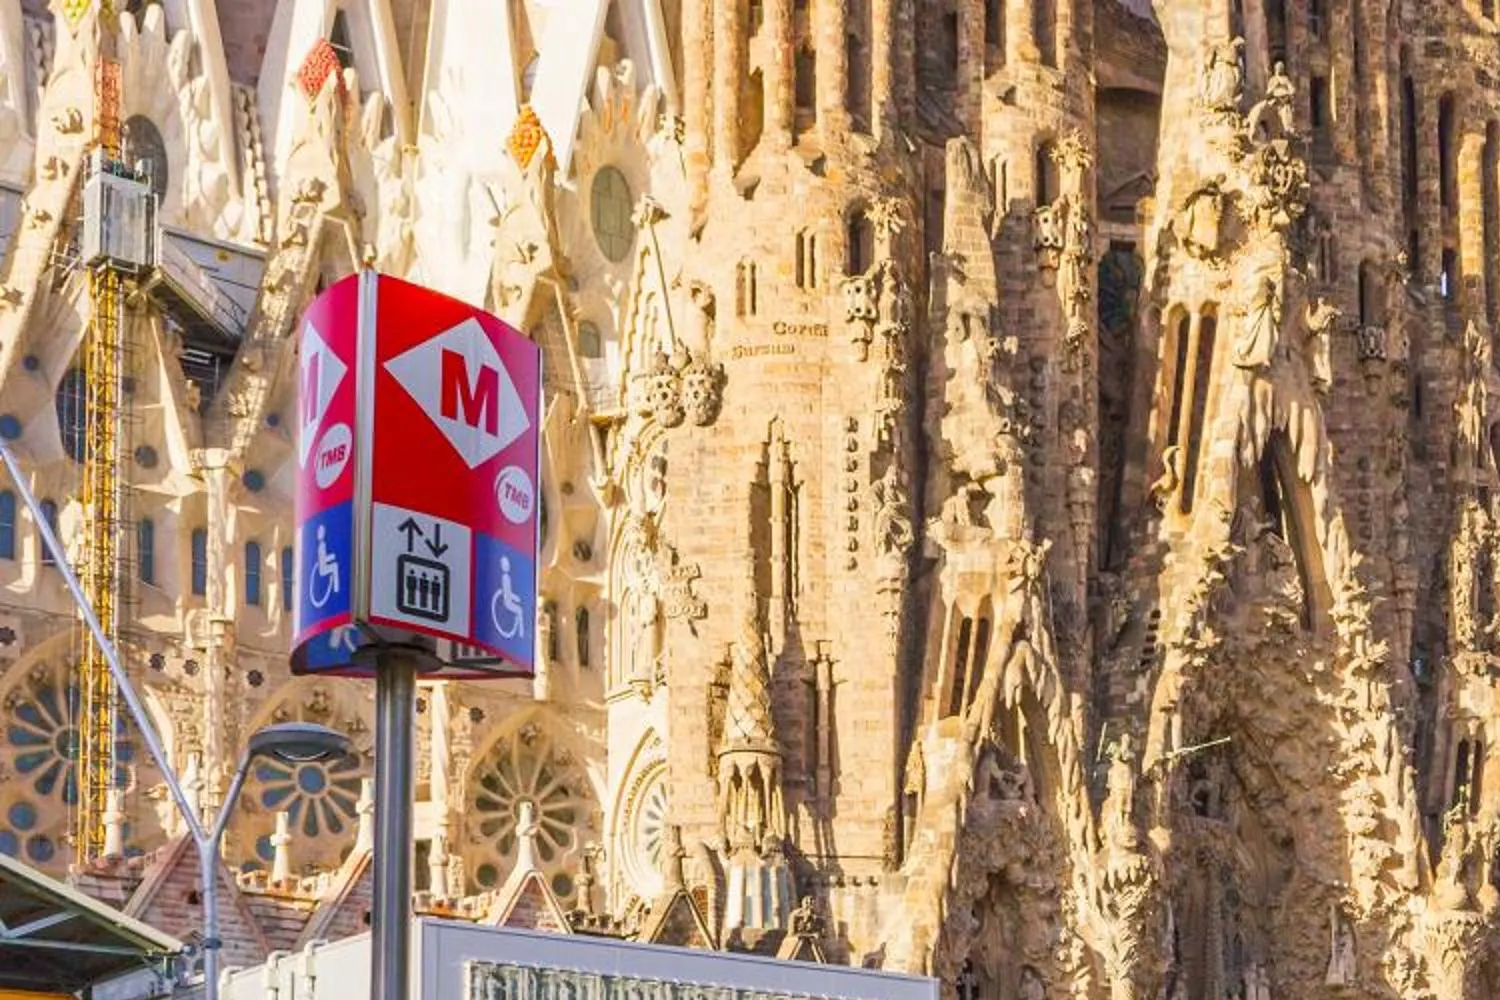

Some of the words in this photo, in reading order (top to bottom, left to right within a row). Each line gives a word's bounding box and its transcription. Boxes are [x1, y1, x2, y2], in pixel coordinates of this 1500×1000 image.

[441, 348, 499, 438] M
[319, 444, 347, 470] TMB
[504, 483, 529, 510] TMB
